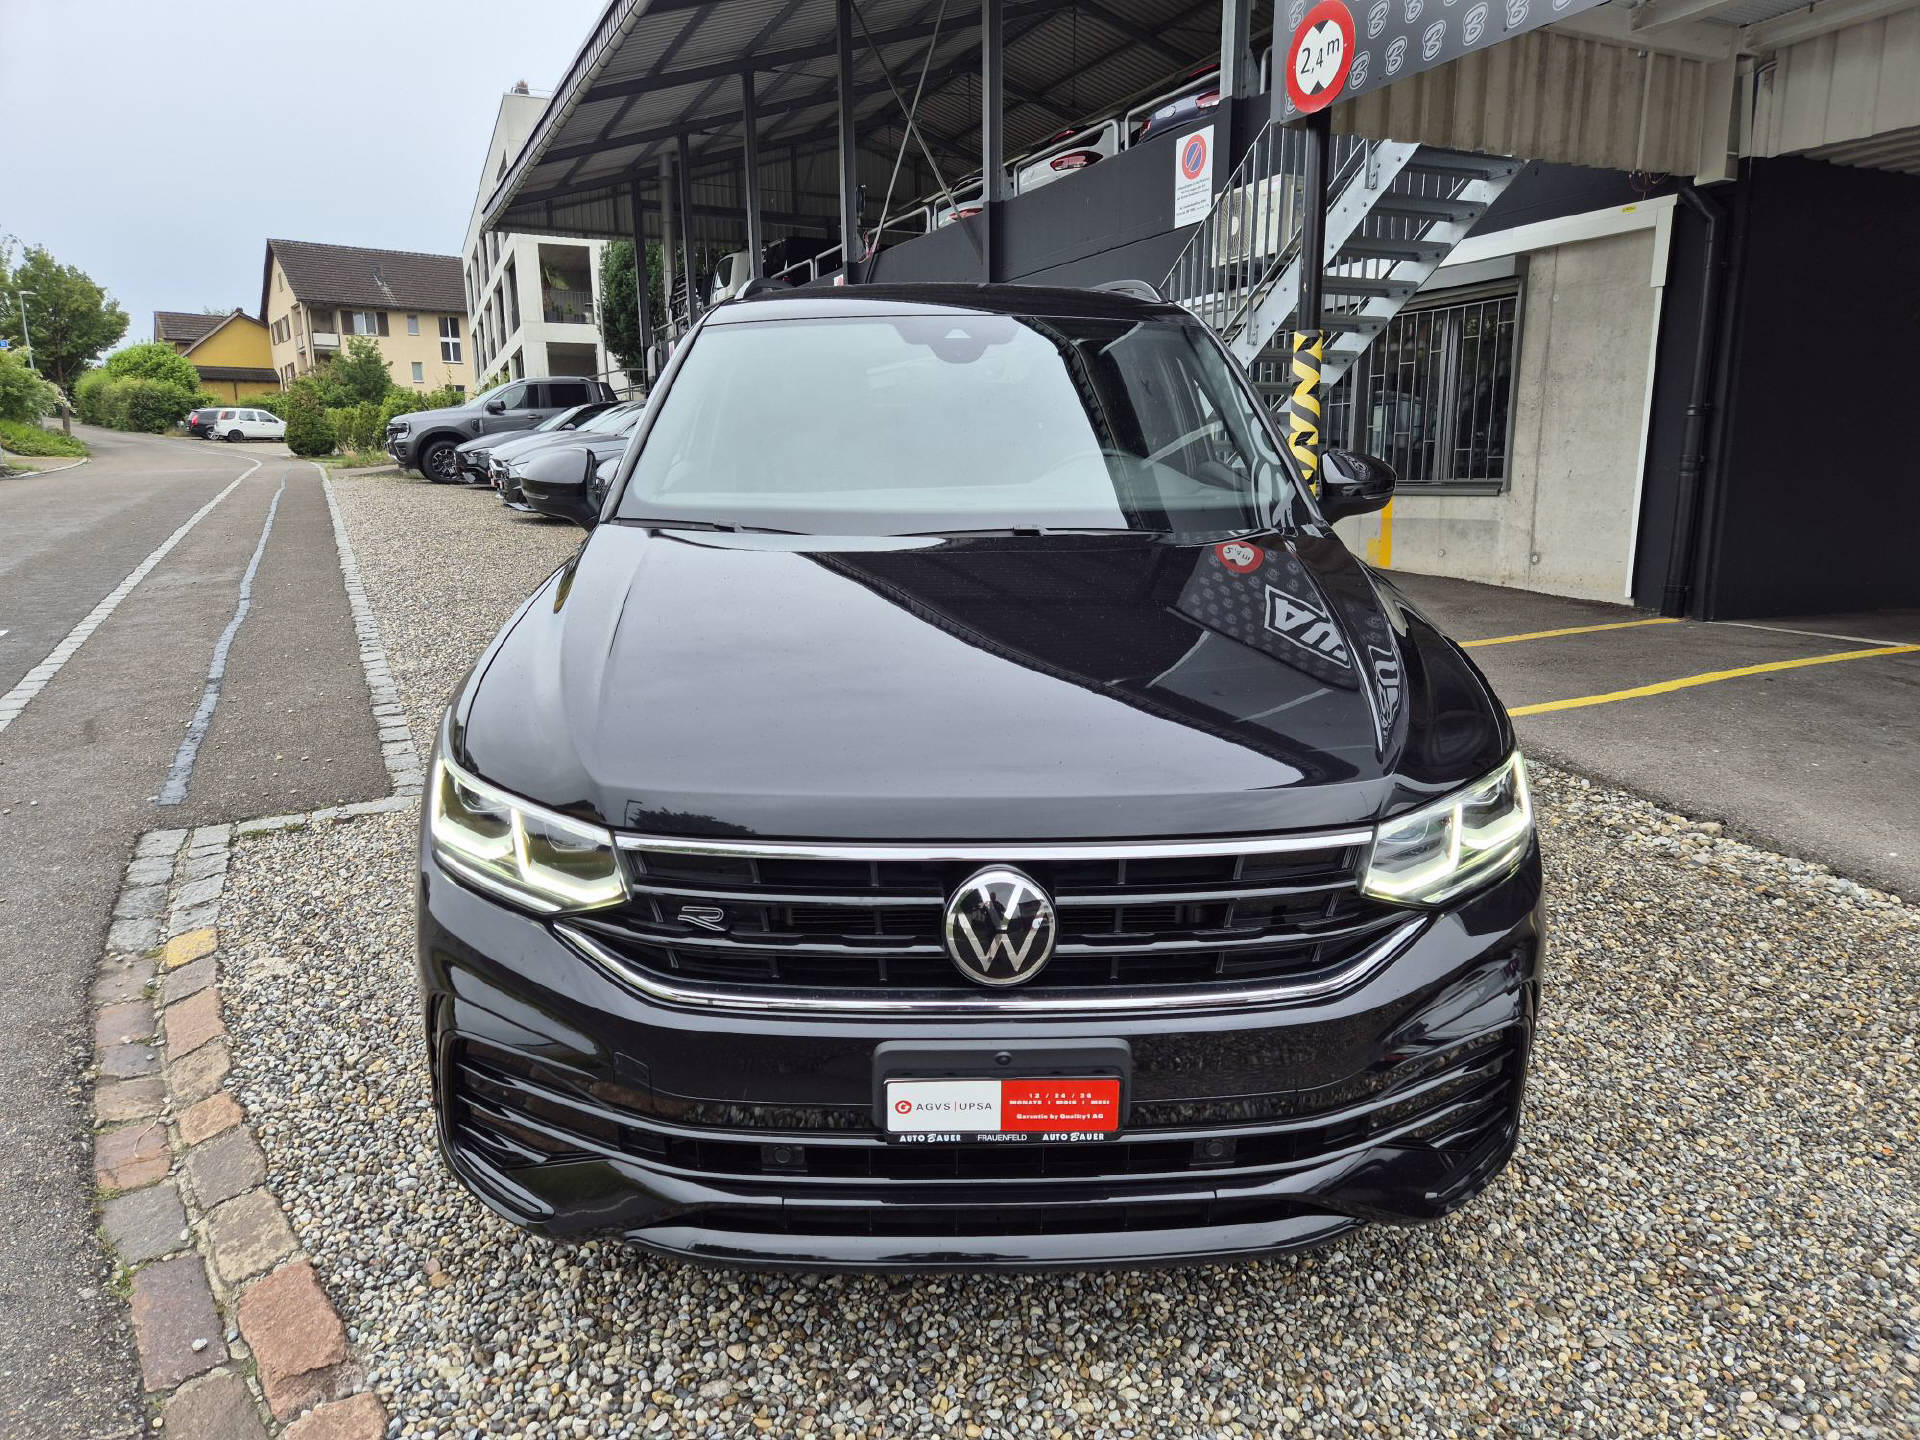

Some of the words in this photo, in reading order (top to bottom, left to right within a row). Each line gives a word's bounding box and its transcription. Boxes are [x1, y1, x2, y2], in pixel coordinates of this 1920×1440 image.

[949, 871, 1053, 981] VW
[915, 1102, 951, 1111] AGVS
[959, 1101, 992, 1111] UPSA
[899, 1134, 925, 1142] AUTO
[927, 1133, 961, 1143] BAUER
[1042, 1133, 1068, 1141] AUTO
[1070, 1132, 1105, 1142] BAUER
